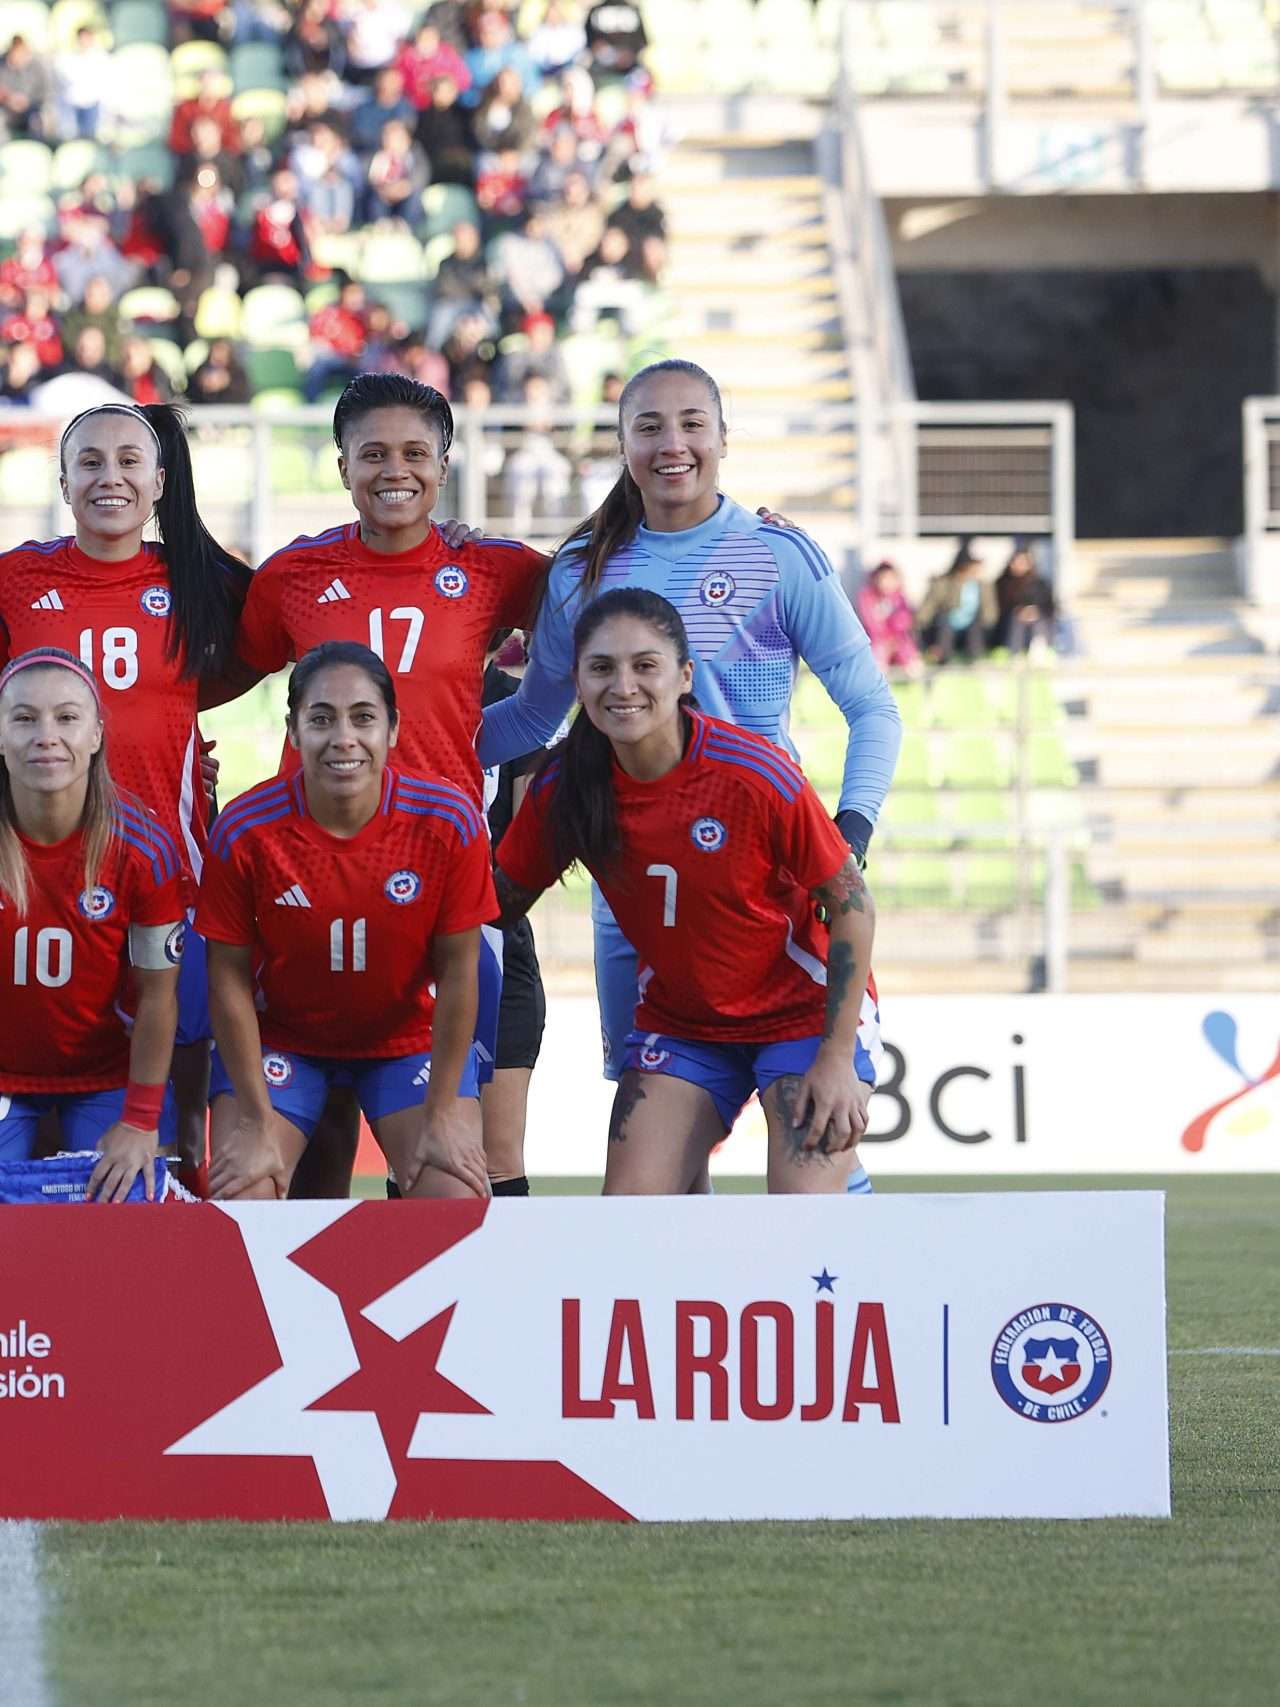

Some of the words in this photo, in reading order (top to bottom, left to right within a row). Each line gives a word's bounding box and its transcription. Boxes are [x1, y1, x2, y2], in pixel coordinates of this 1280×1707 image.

[79, 626, 139, 690] 18
[368, 606, 425, 673] 17
[646, 863, 678, 928] 7
[13, 926, 73, 988] 10
[329, 917, 367, 972] 11
[862, 1034, 1028, 1144] Bci
[562, 1298, 656, 1419] LA
[675, 1299, 901, 1424] ROJA
[1058, 1307, 1078, 1325] DE
[1078, 1317, 1108, 1364] FUTBOL
[1023, 1401, 1042, 1419] DE
[1047, 1399, 1084, 1421] CHILE
